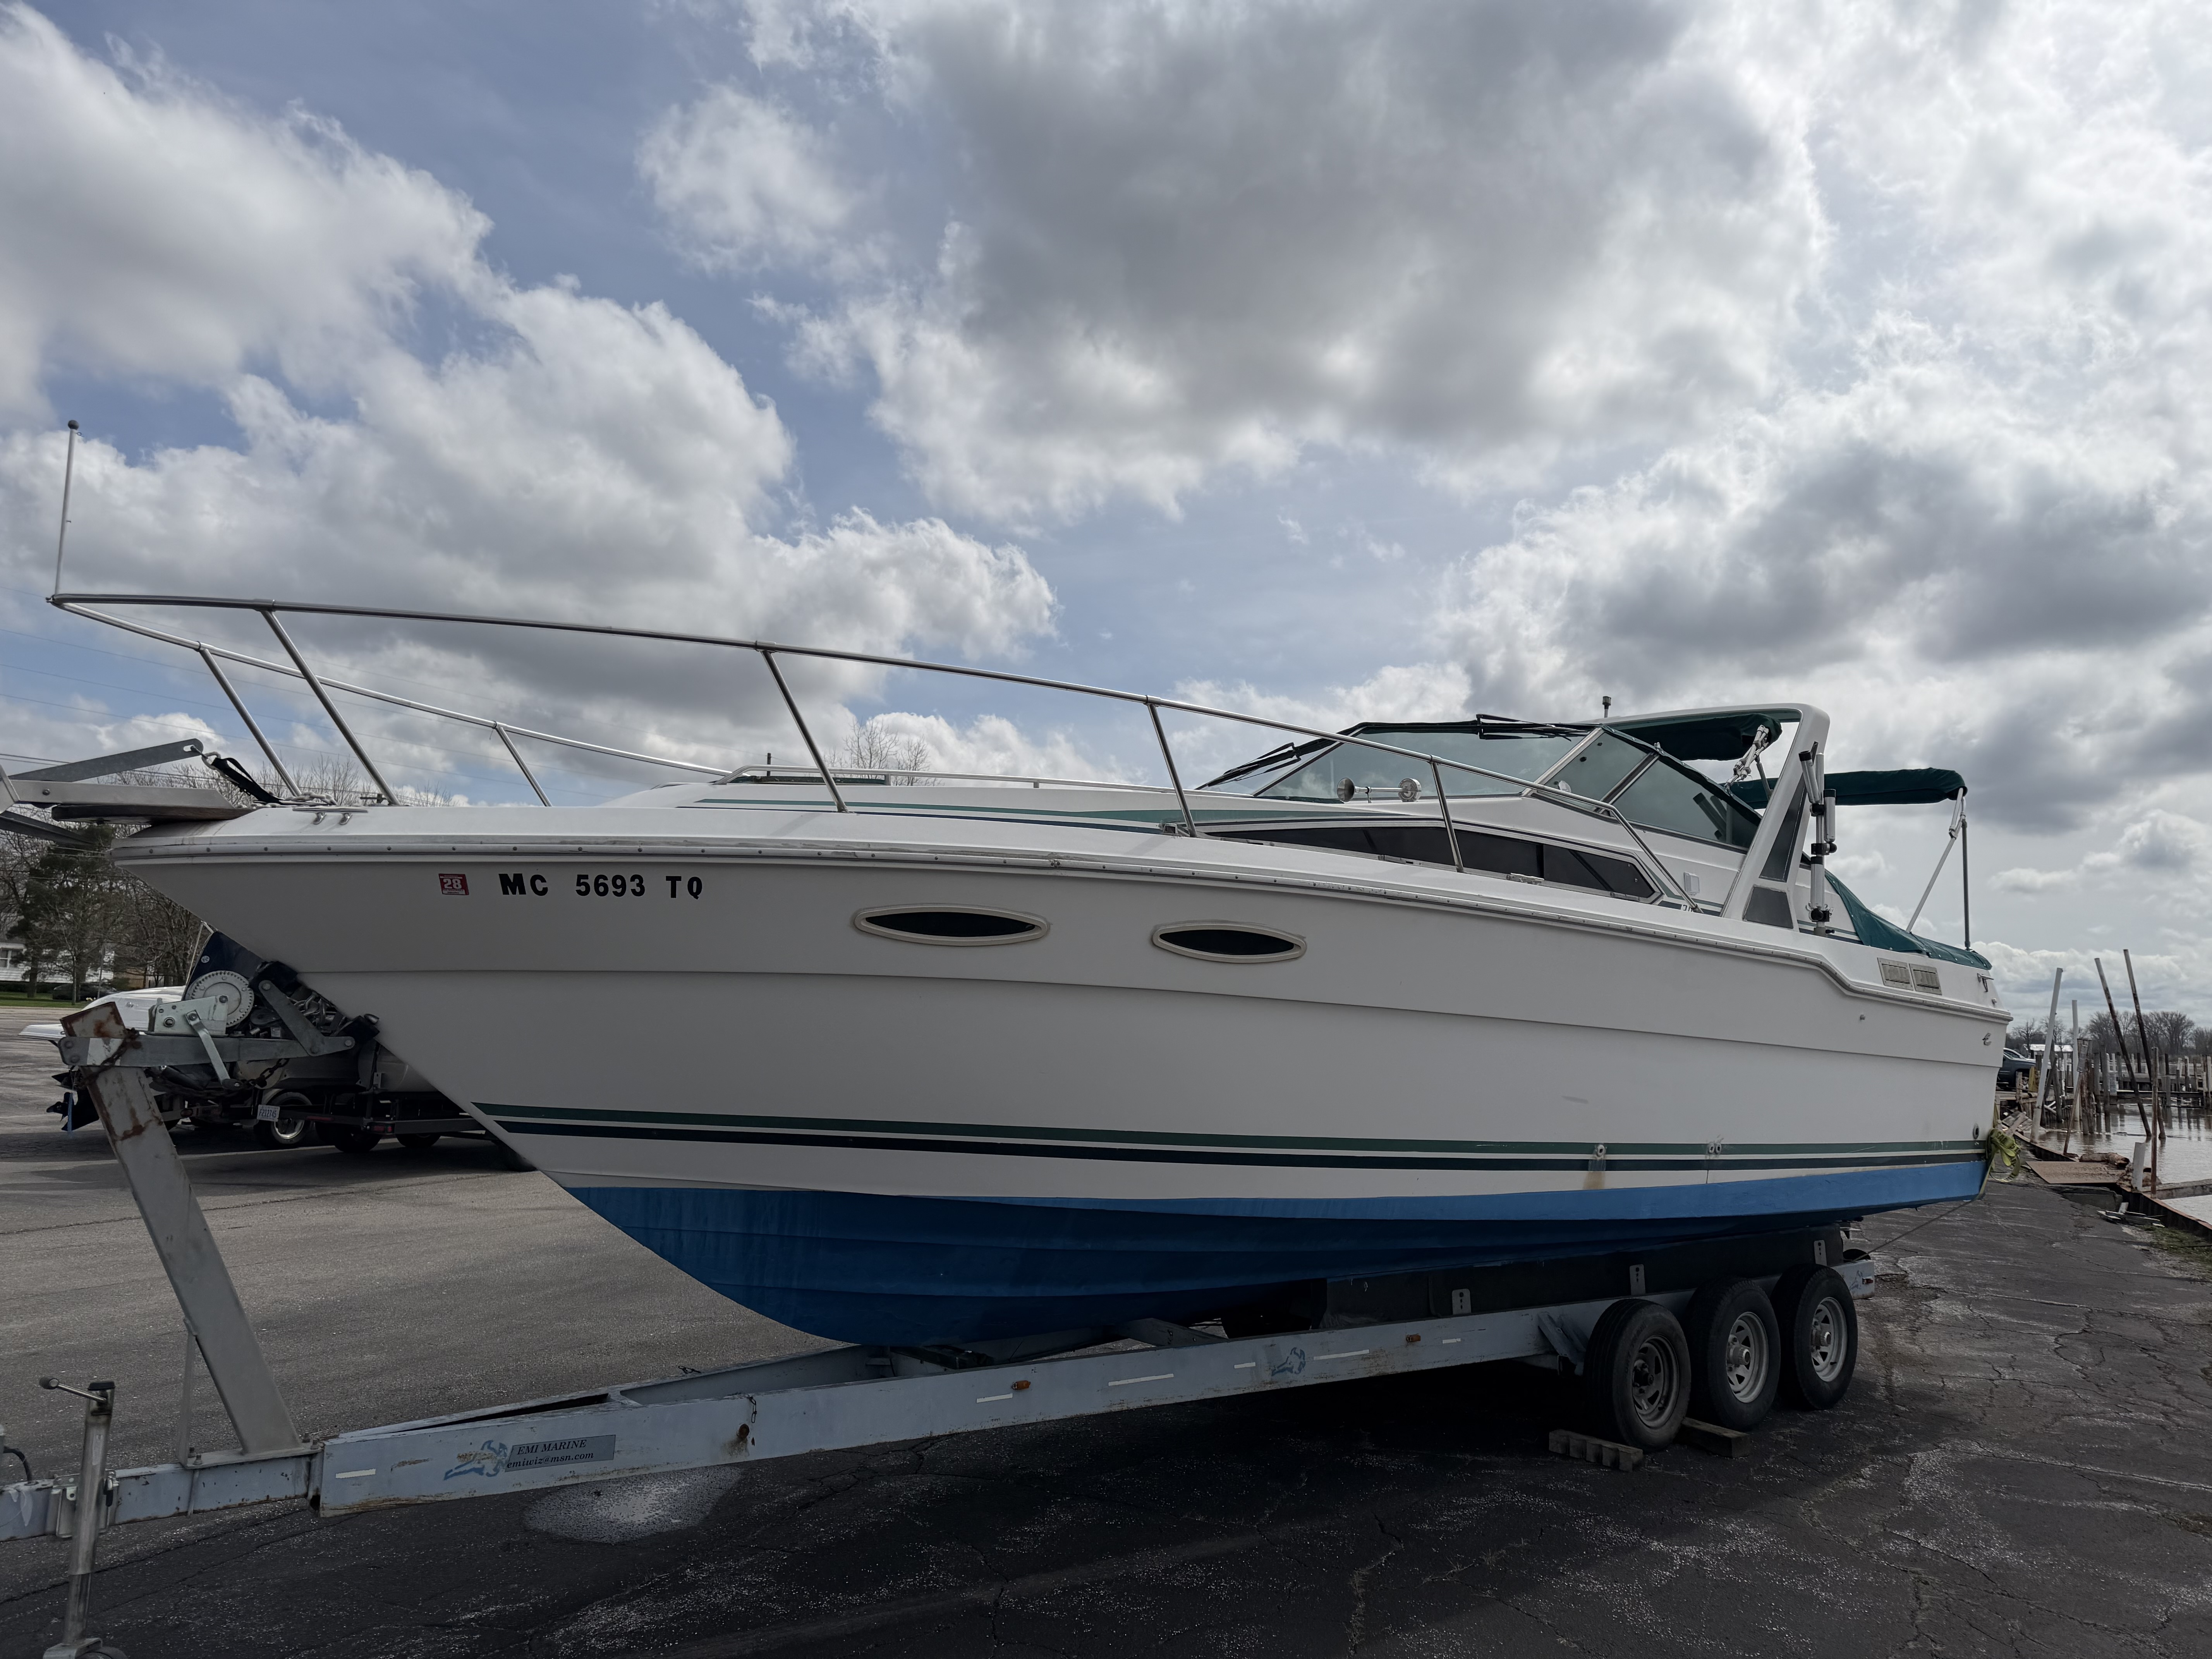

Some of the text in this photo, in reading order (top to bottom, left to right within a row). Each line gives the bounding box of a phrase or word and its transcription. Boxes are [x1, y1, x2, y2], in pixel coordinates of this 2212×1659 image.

[443, 879, 462, 889] 28
[498, 874, 702, 900] MC 5693 TQ
[517, 1439, 587, 1455] EMI MARINE
[507, 1453, 594, 1468] emiwiz@msn.com
